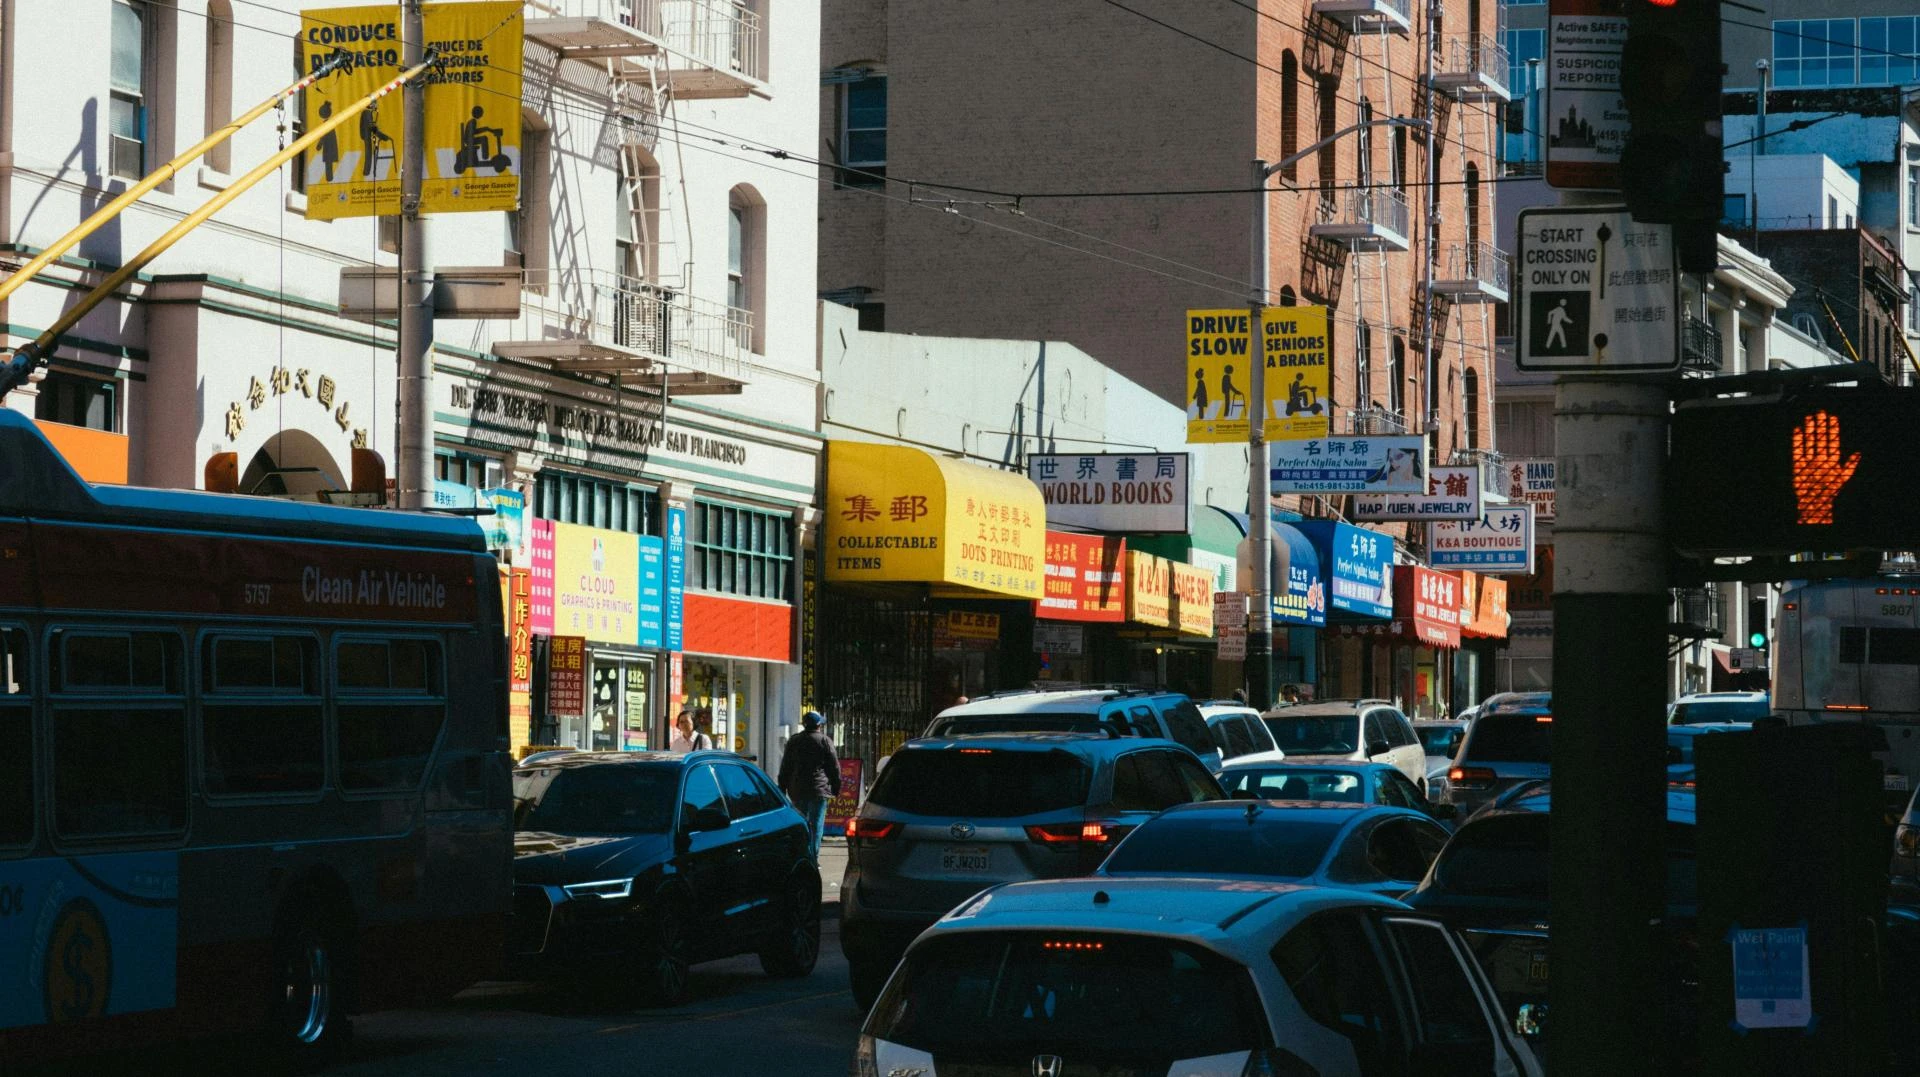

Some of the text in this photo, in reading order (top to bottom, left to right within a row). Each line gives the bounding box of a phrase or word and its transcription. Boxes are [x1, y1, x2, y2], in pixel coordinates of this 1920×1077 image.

[308, 22, 396, 44] CONDUCE
[1557, 22, 1588, 32] Active
[1590, 22, 1618, 32] SAFE
[467, 40, 483, 51] DE
[311, 48, 398, 71] DEPACIO
[427, 70, 484, 84] MAYORES
[1560, 72, 1622, 83] REPORTE
[1540, 228, 1584, 243] START
[1623, 232, 1659, 248] 只可在
[1527, 249, 1597, 264] CROSSING
[1532, 270, 1590, 285] ONLY ON
[1608, 271, 1672, 287] 此信號燈時
[1614, 307, 1667, 323] 開始過街
[1191, 316, 1248, 334] DRIVE
[1266, 321, 1297, 335] GIVE
[1191, 338, 1248, 356] SLOW
[1266, 336, 1325, 352] SENIORS
[1267, 352, 1325, 368] A BRAKE
[650, 426, 664, 448] OF
[666, 433, 688, 454] SAN
[691, 436, 746, 466] FRANCISCO
[1304, 440, 1368, 456] 名師廊
[1037, 456, 1175, 481] 世界書局
[1278, 458, 1367, 469] Perfect Styling Salon
[1527, 464, 1554, 479] HANG
[1042, 481, 1173, 504] WORLD BOOKS
[841, 495, 928, 523] 集郵
[1359, 503, 1382, 514] HAP
[1418, 503, 1472, 513] JEWELRY
[1536, 503, 1546, 513] IM
[838, 536, 938, 549] COLLECTABLE
[1437, 536, 1521, 548] K&A BOUTIQUE
[838, 557, 881, 569] ITEMS
[962, 543, 1034, 572] DOTS PRINTING
[244, 565, 446, 608] 5757 Clean Air Vehicle
[581, 575, 615, 595] CLOUD
[1139, 564, 1144, 592] A
[1147, 566, 1152, 593] &
[1155, 568, 1160, 596] A
[1162, 569, 1195, 604] MSSAGE
[1197, 577, 1209, 607] SPA
[561, 593, 633, 614] GRAPHICS & PRINTING
[1881, 605, 1913, 616] 5807
[514, 572, 528, 681] 工作介绍
[552, 638, 581, 653] 雅房
[552, 654, 581, 670] 出租
[1737, 932, 1800, 944] Wet Paint
